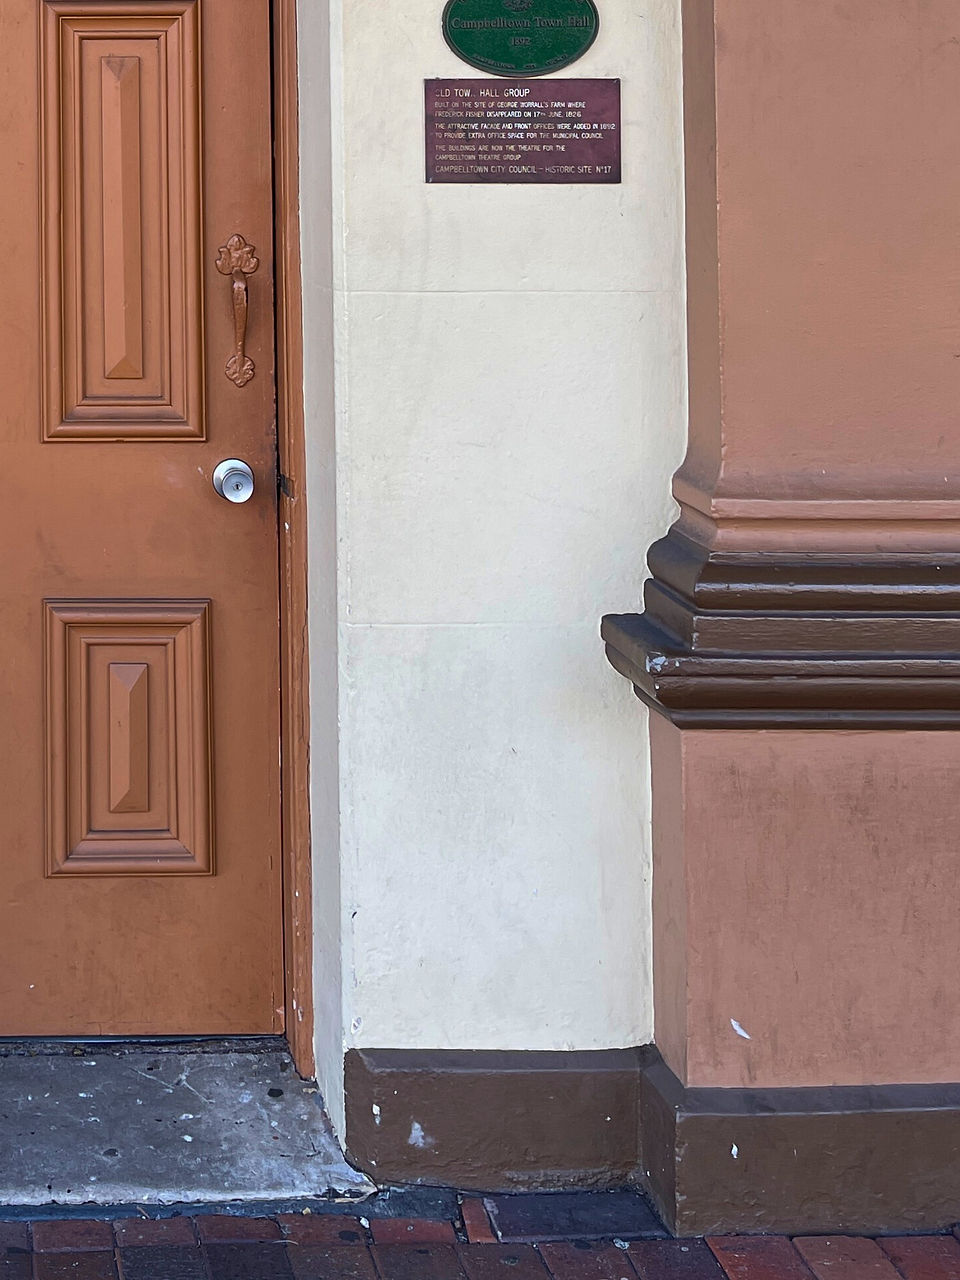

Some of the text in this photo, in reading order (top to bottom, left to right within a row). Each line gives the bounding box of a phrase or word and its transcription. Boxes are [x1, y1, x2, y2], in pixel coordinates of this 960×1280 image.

[451, 16, 590, 31] Campbelltown Town Hall
[511, 37, 531, 47] 1892
[480, 89, 499, 97] HALL
[504, 89, 530, 97] GROUP
[435, 165, 489, 174] CAMPBELLTOWN
[490, 165, 506, 174] CITY
[508, 165, 537, 174] COUNCIL
[545, 165, 576, 174] HISTORIC
[577, 165, 593, 174] SITE
